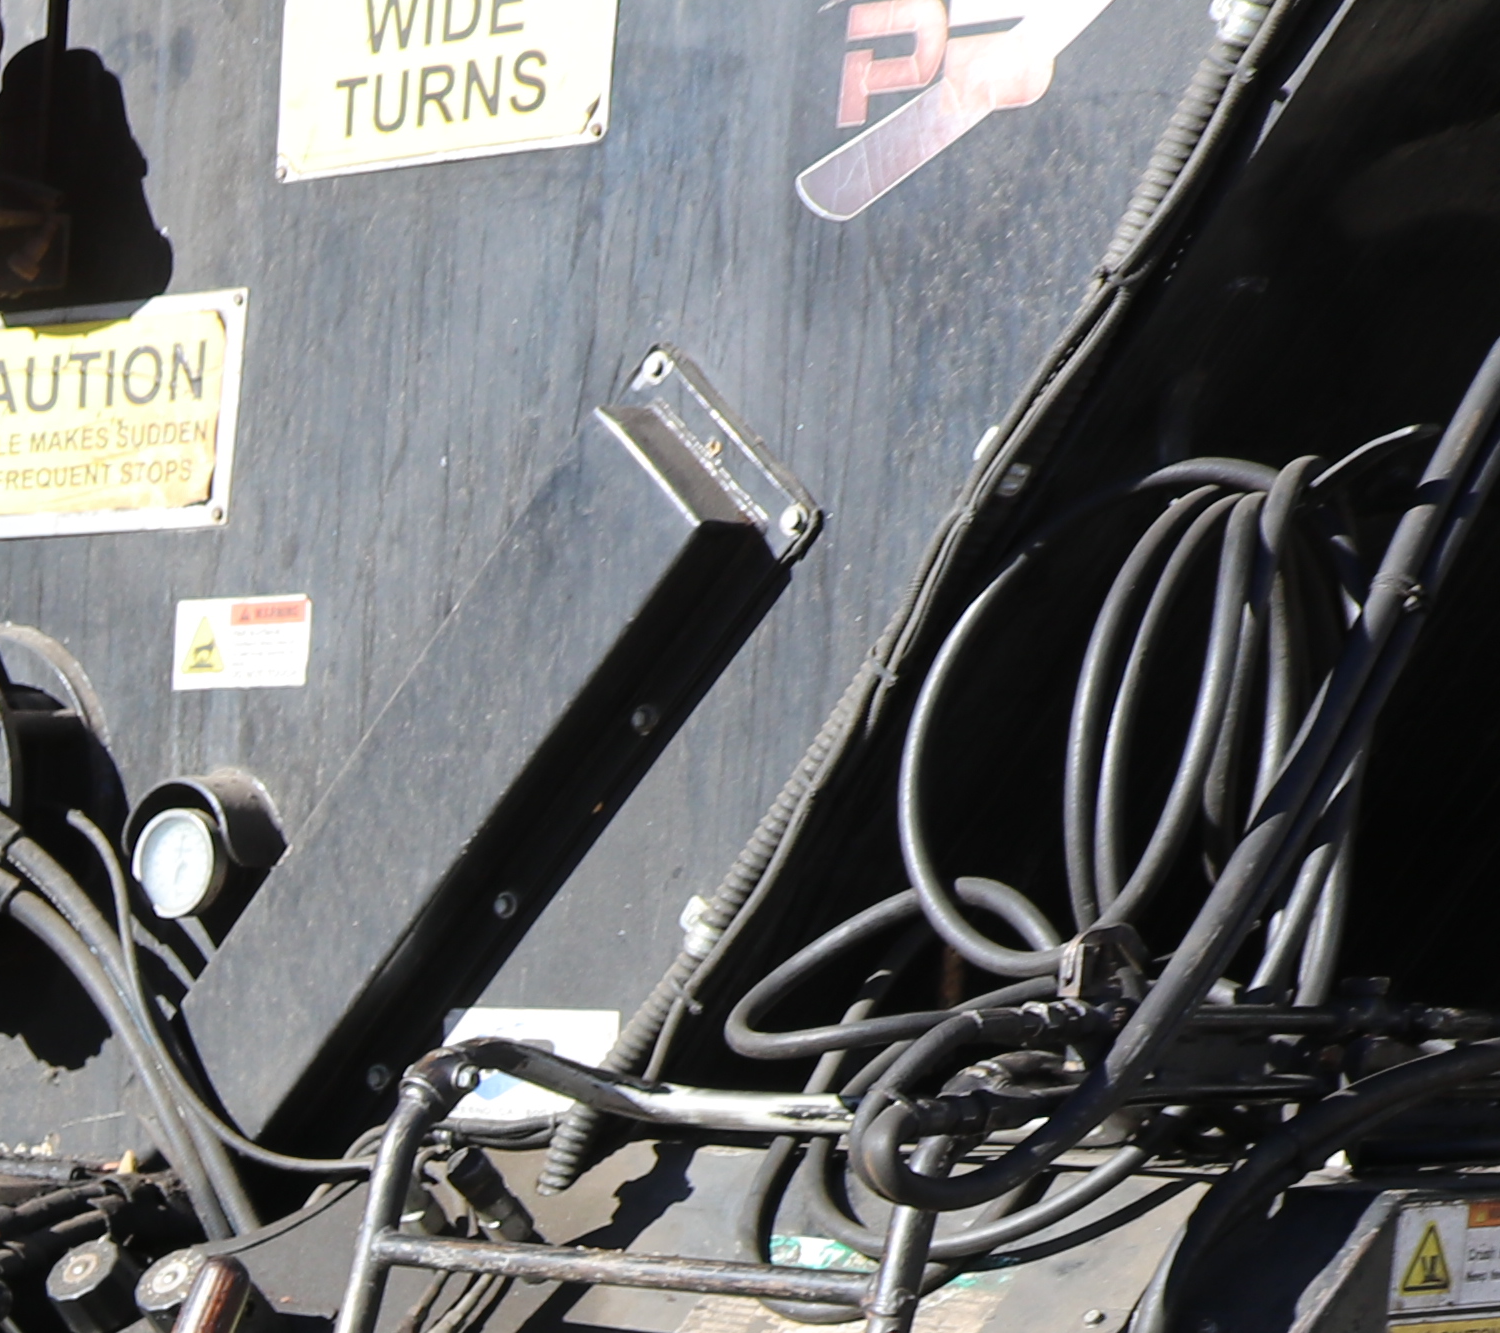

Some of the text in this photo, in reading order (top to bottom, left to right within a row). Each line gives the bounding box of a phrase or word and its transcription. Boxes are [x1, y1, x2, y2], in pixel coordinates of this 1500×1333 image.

[365, 0, 524, 55] WIDE
[336, 49, 547, 138] TURNS
[30, 426, 108, 454] MAKES
[116, 420, 209, 450] SUDDEN
[120, 458, 192, 484] STOPS
